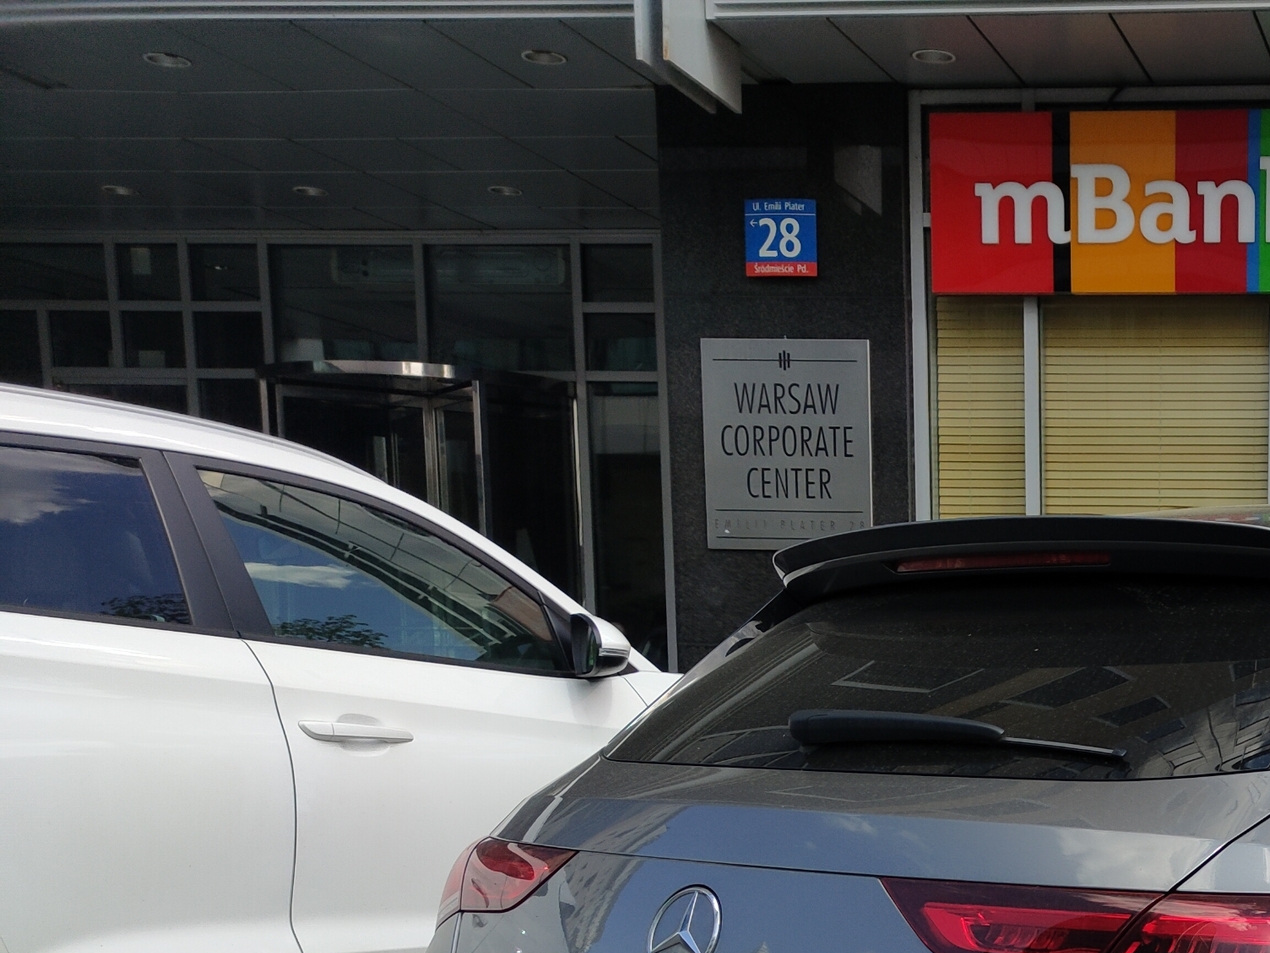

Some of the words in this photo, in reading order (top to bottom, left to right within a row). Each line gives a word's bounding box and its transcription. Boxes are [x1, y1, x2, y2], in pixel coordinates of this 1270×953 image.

[764, 201, 782, 211] Emilii
[784, 202, 805, 211] Plater
[758, 217, 802, 258] 28
[753, 262, 794, 273] Śródmieście
[733, 382, 840, 415] WARSAW
[720, 425, 854, 458] CORPORATE
[746, 467, 832, 499] CENTER
[780, 519, 836, 531] PLATER
